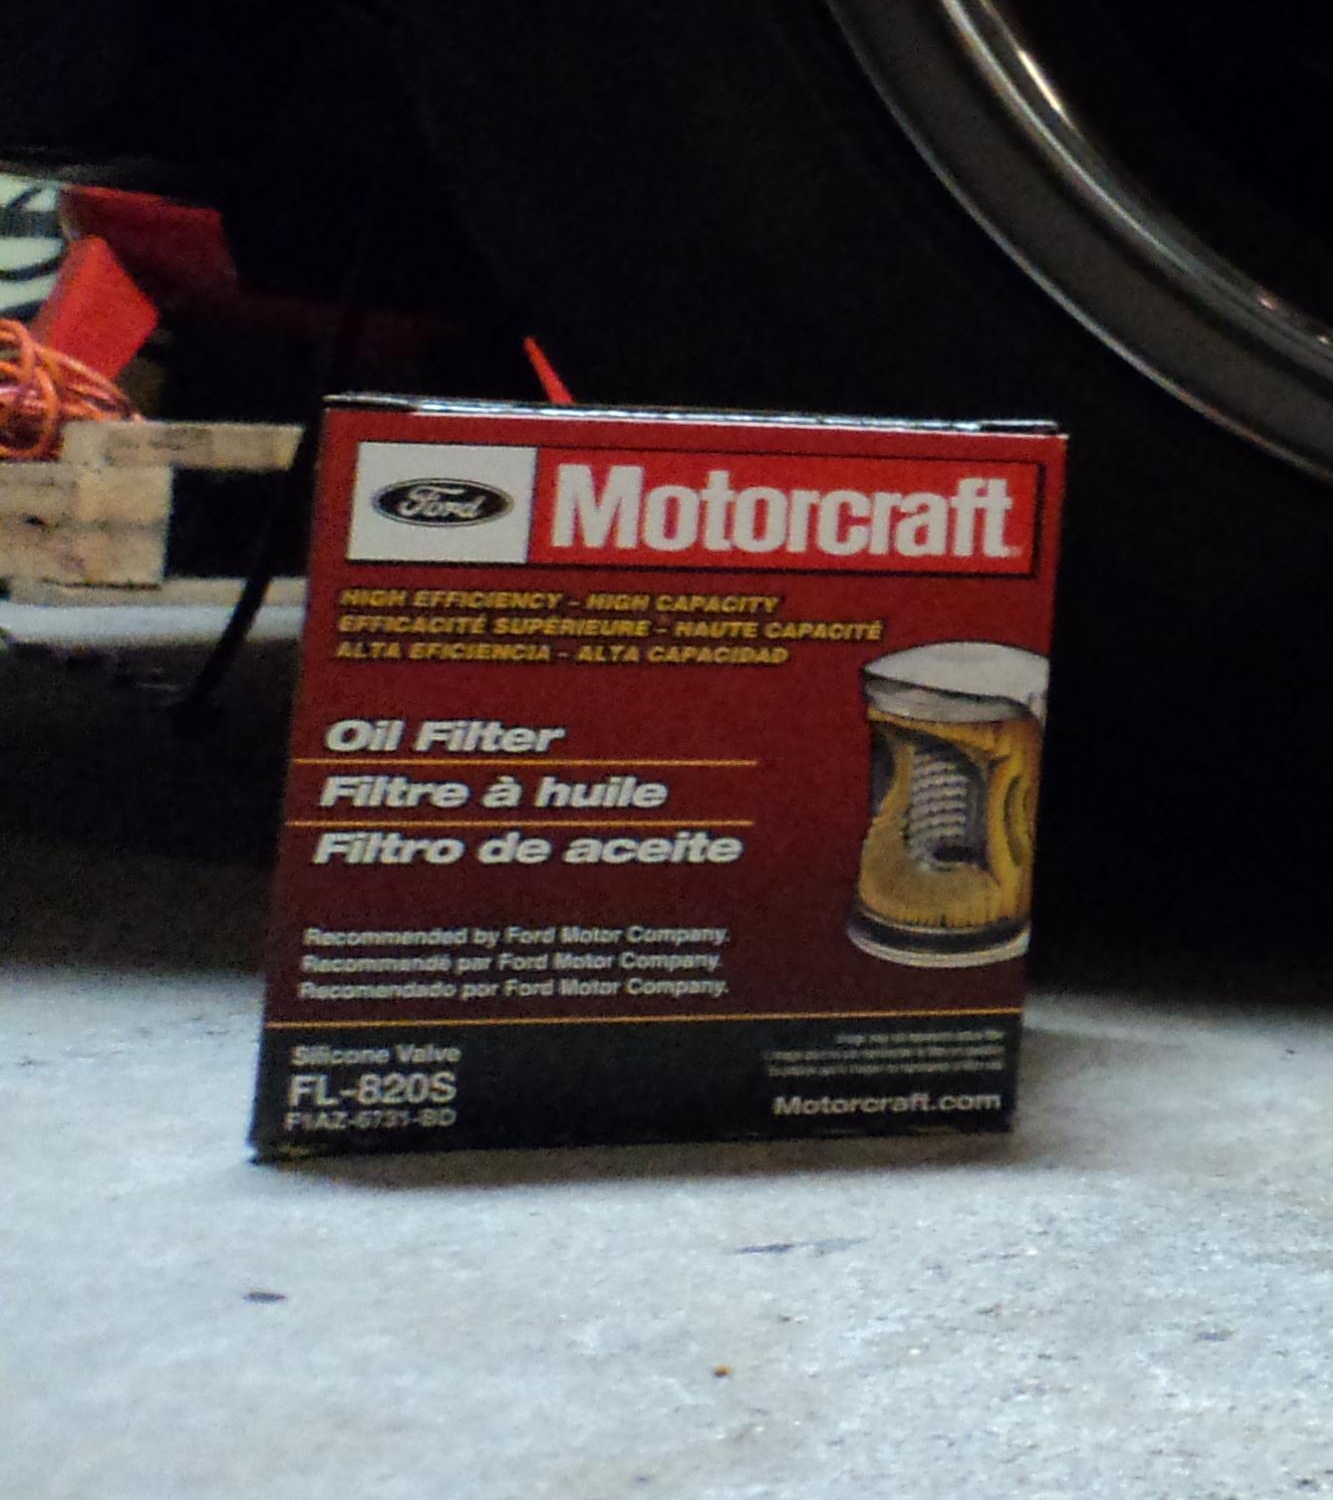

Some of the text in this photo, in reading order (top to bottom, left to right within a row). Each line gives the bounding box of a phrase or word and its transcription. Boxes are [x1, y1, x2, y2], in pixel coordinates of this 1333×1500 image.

[398, 463, 1014, 558] Ford Motorcraft
[340, 590, 408, 607] HIGH
[413, 591, 563, 609] EFFICIENCY
[586, 594, 648, 611] HIGH
[655, 595, 780, 614] CAPACITY
[338, 613, 486, 634] EFFICACITÉ
[676, 622, 758, 638] HAUTE
[764, 619, 884, 641] CAPACITÉ
[336, 642, 401, 659] ALTA
[408, 643, 550, 661] EFICIENCIA
[577, 646, 640, 662] ALTA
[647, 646, 788, 664] CAPACIDAD
[325, 720, 565, 752] Oil Filter
[320, 776, 668, 808] Filtre à huile
[313, 831, 743, 865] Filtro de aceite
[304, 928, 467, 946] Recommended
[472, 928, 498, 948] by
[506, 927, 556, 944] Ford
[560, 927, 621, 944] Motor
[456, 958, 492, 974] par
[499, 953, 549, 971] Ford
[554, 953, 613, 971] Motor
[300, 981, 456, 999] Recomendado
[461, 984, 498, 1000] por
[505, 980, 555, 997] Ford
[559, 980, 621, 996] Motor
[292, 1045, 462, 1065] Silicone Valve
[290, 1072, 457, 1105] FL-820S
[773, 1093, 1001, 1116] Motorcraft.com
